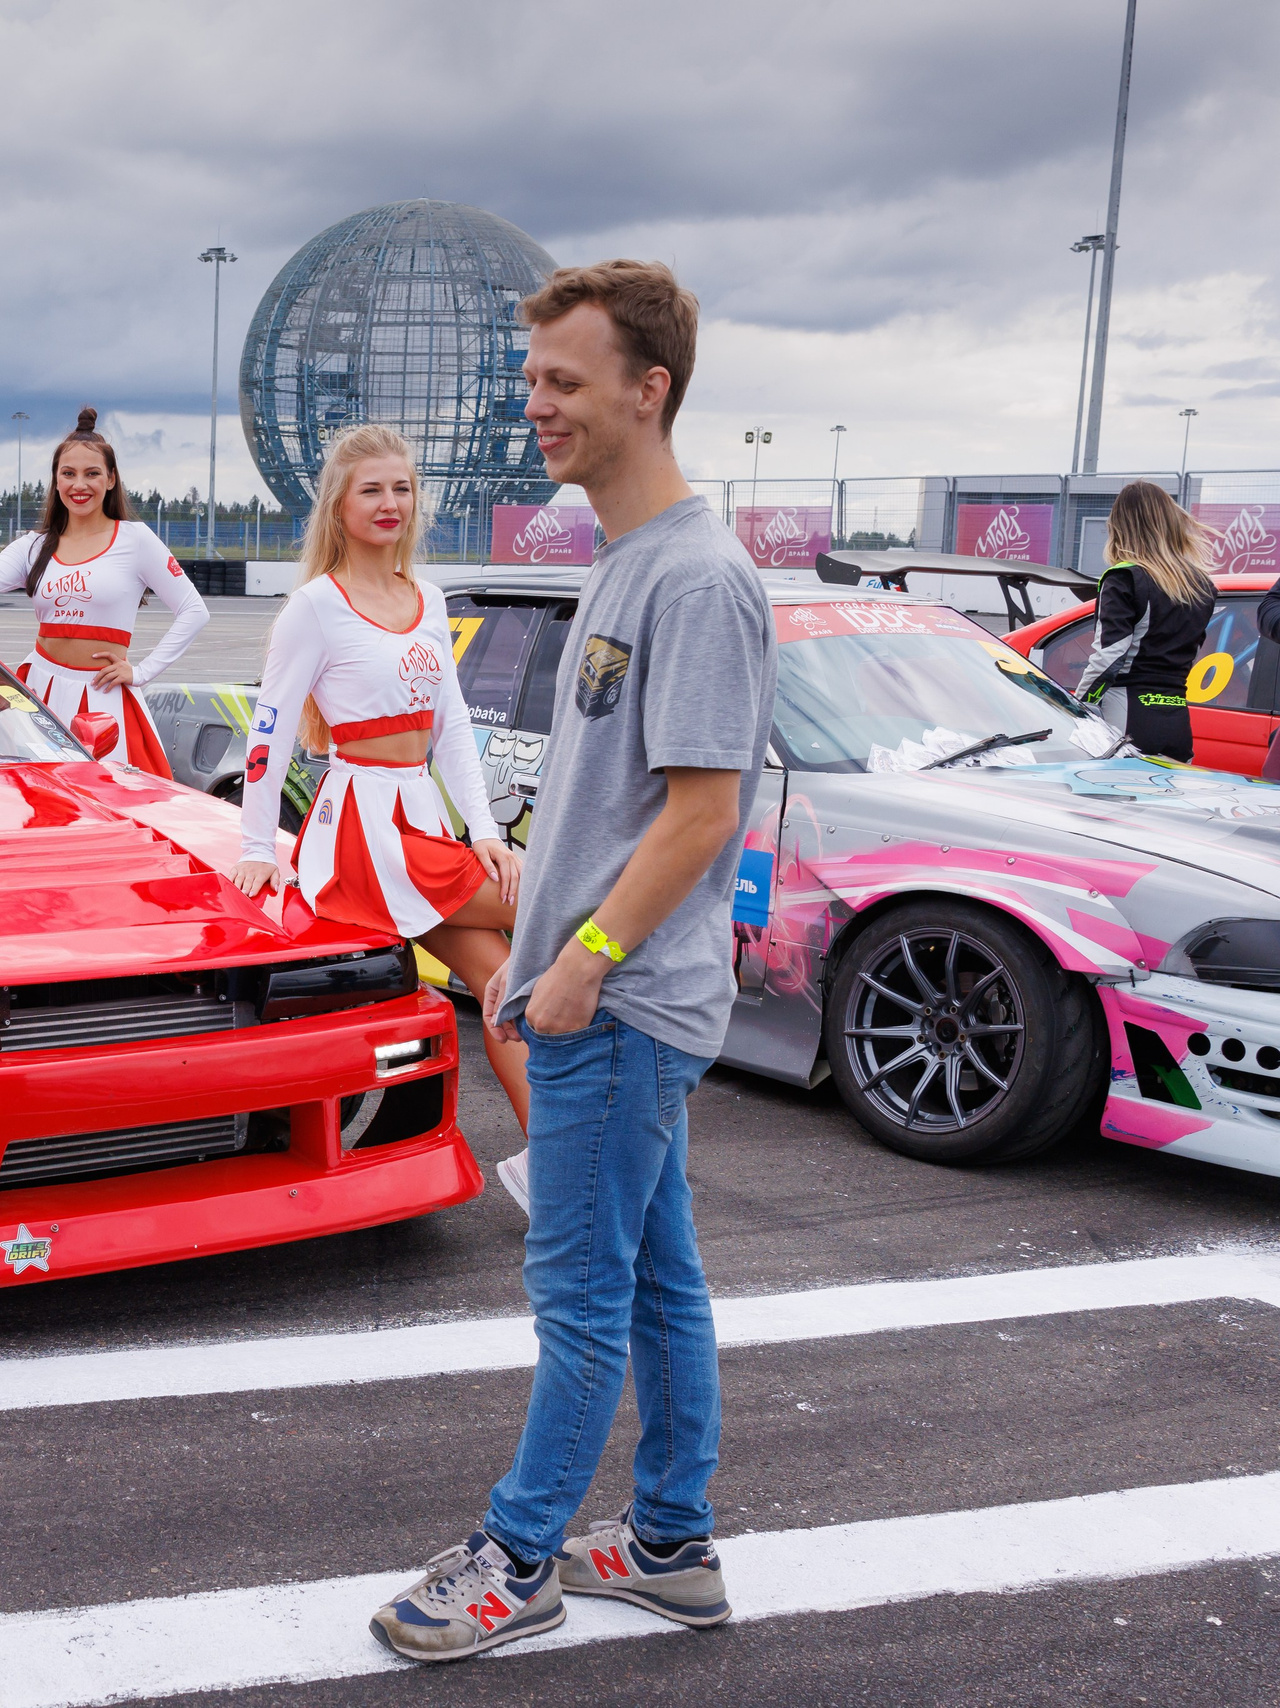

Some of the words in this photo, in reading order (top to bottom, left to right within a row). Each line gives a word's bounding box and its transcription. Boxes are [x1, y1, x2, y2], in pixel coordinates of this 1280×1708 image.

[872, 603, 907, 611] DRIVE
[54, 609, 84, 618] ДРАЙВ
[836, 609, 926, 628] IDDC
[857, 626, 884, 634] DRIFT
[884, 627, 935, 635] CHALLENGE
[12, 1242, 45, 1252] LET'S
[10, 1250, 47, 1260] DRIFT
